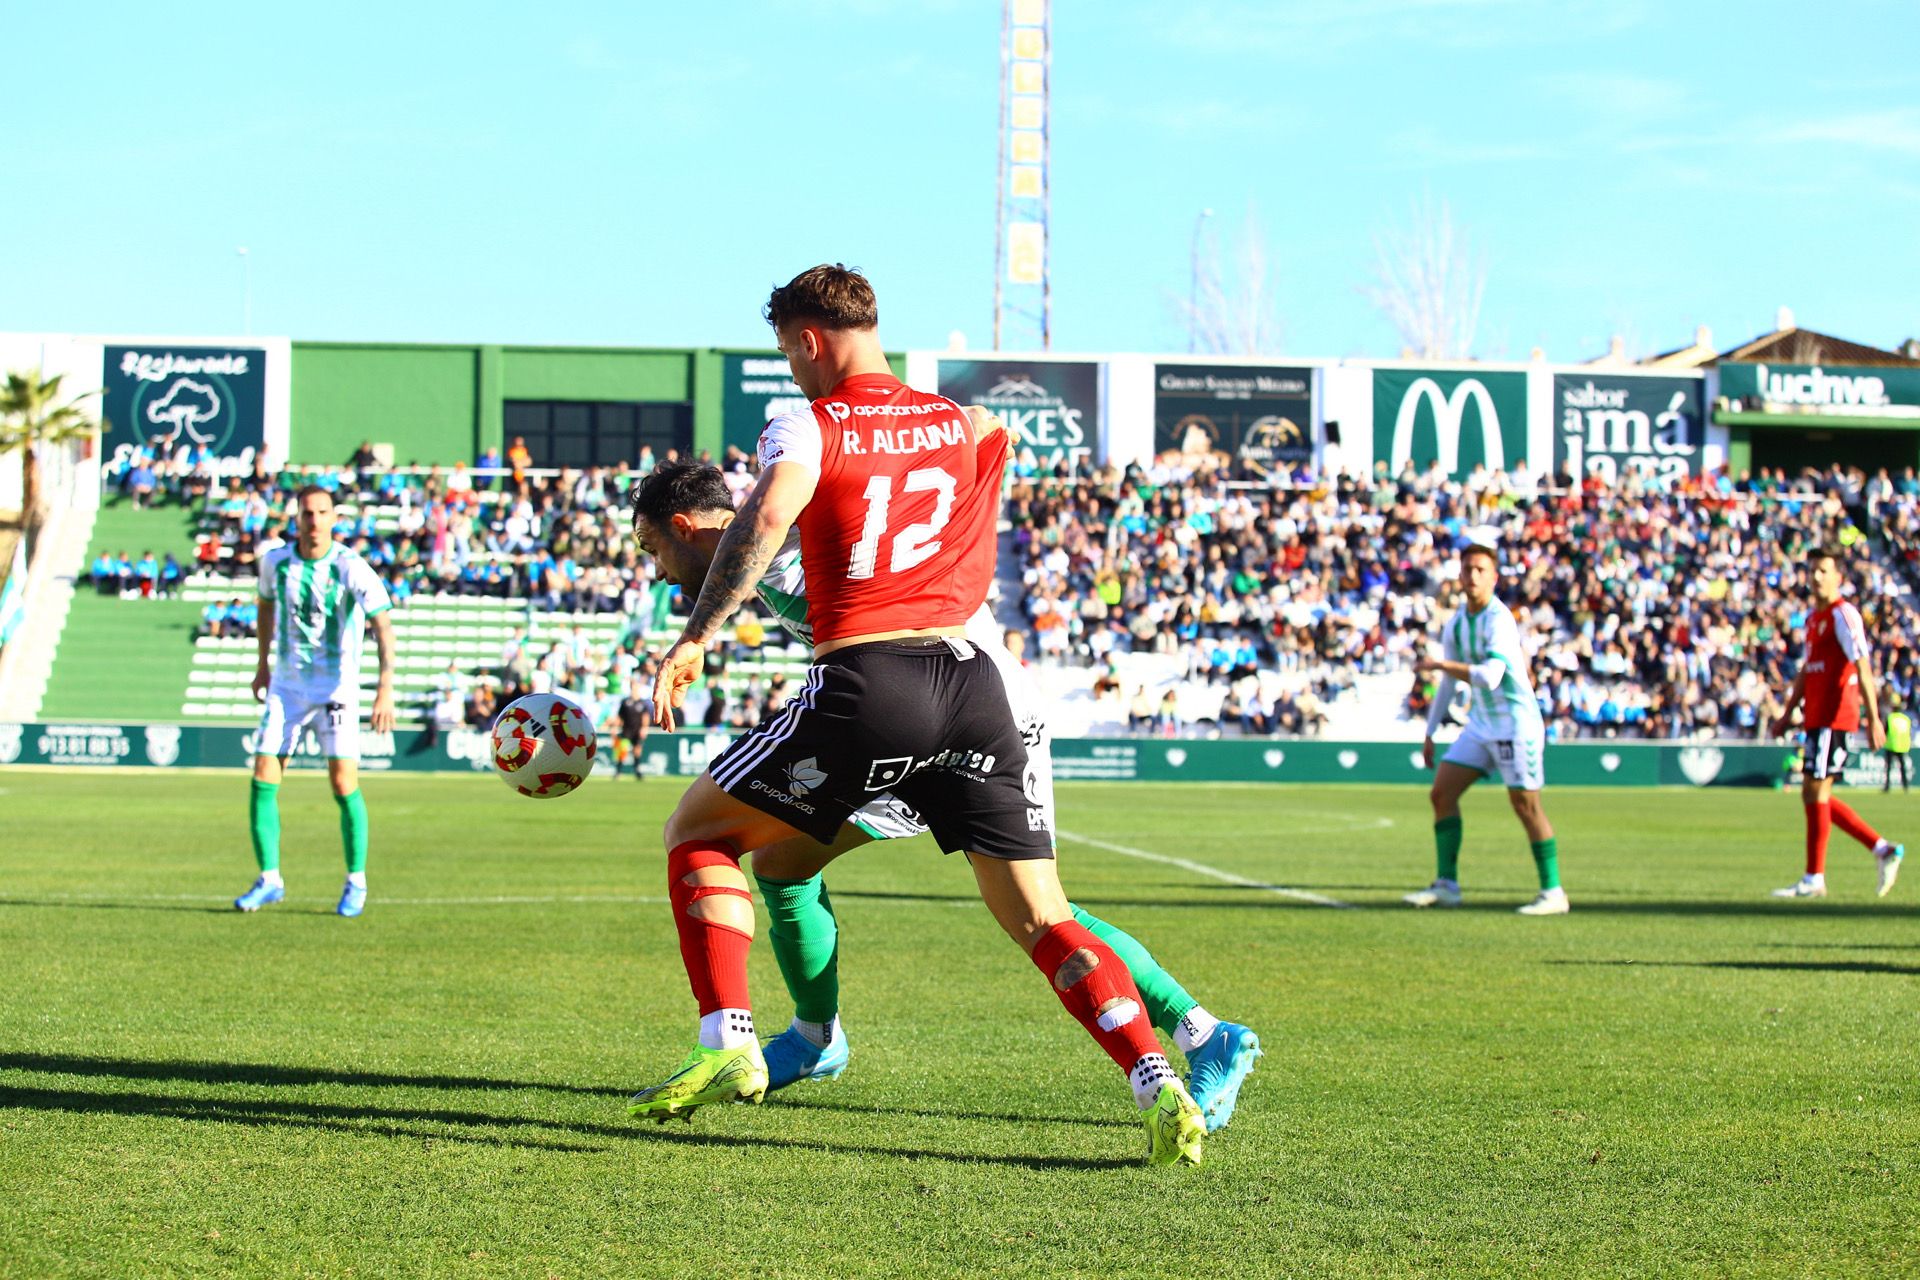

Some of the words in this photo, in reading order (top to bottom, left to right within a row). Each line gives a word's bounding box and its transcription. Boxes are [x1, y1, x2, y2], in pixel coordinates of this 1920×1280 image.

[1563, 381, 1629, 409] sabor
[843, 430, 867, 456] R.
[872, 419, 967, 455] ALCAINA
[847, 466, 957, 579] 12
